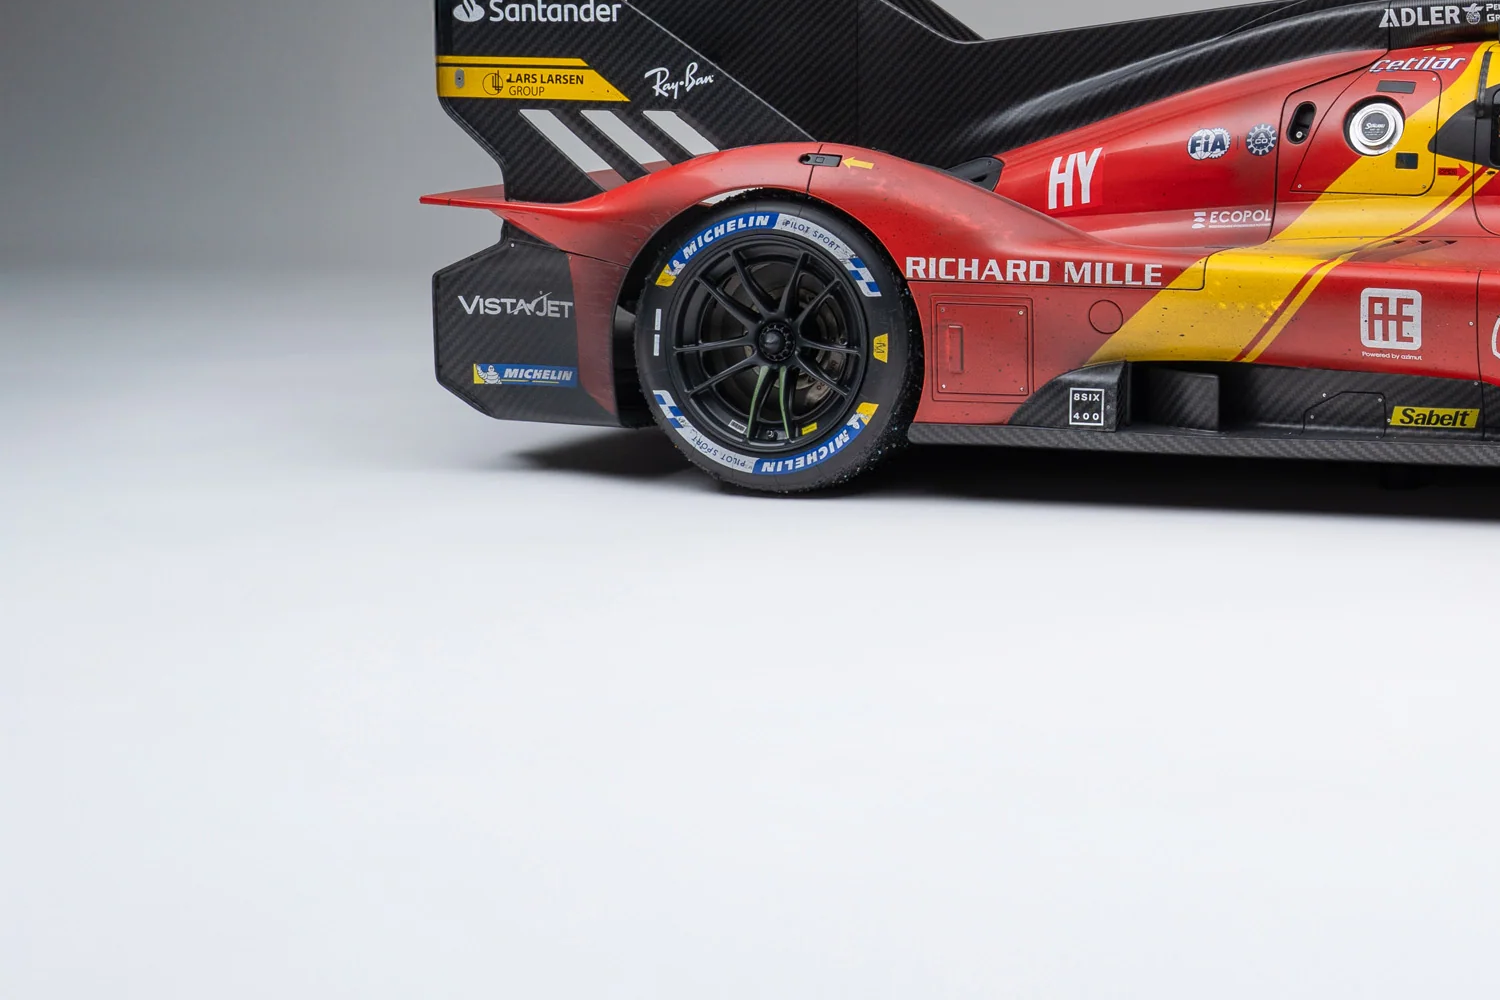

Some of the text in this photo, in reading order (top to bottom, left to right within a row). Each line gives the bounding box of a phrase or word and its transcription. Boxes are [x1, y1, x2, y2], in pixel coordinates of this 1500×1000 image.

[1378, 5, 1461, 28] ADLER
[508, 73, 584, 85] LARS LARSEN
[509, 85, 545, 97] GROUP
[1048, 147, 1103, 210] HY
[1209, 209, 1272, 224] ECOPOL
[682, 214, 770, 260] MICHELIN
[785, 219, 841, 252] PILOT SPORT
[905, 256, 1163, 287] RICHARD MILLE
[1361, 351, 1390, 359] Powered
[1391, 352, 1400, 360] by
[503, 367, 573, 381] MICHELIN
[1073, 392, 1101, 402] 8SIX
[1399, 407, 1470, 427] Sabelt
[690, 434, 746, 468] PILOT SPORT
[760, 428, 851, 473] MICHELIN
